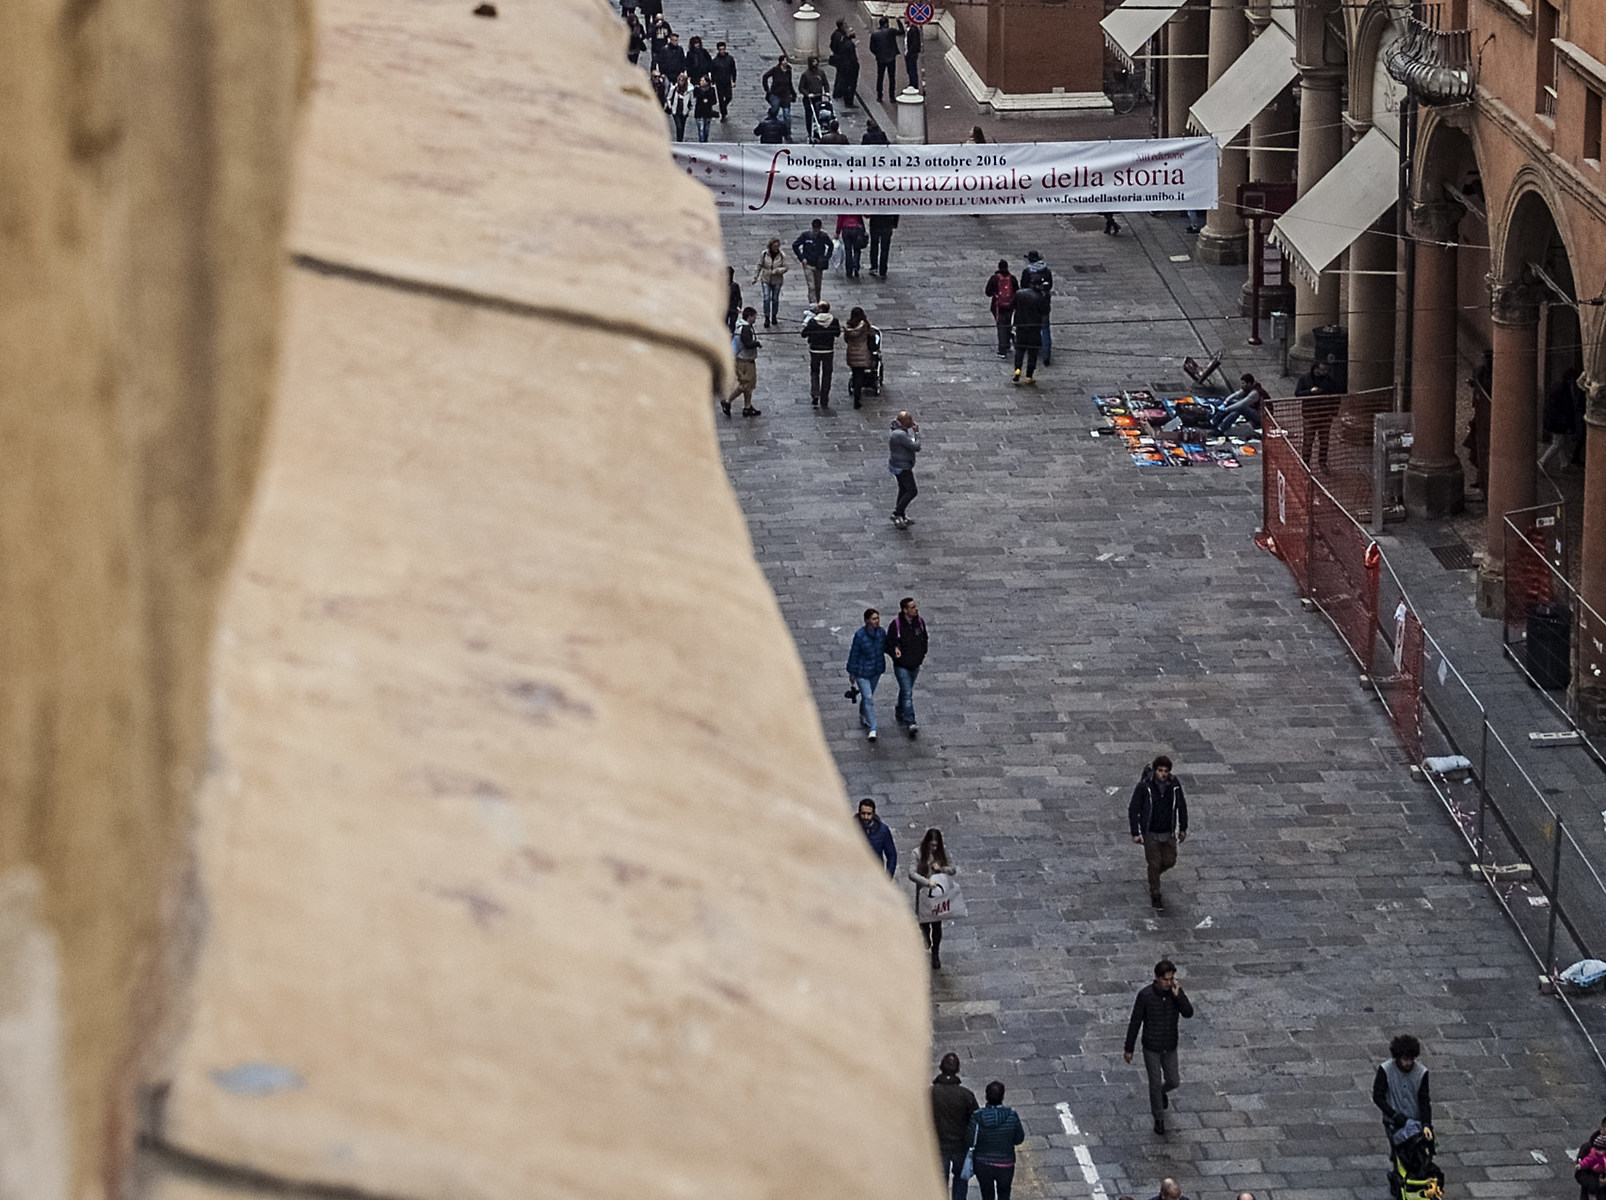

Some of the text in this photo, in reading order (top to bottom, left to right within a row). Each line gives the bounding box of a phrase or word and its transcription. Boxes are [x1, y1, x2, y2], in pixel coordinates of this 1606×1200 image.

[787, 155, 1007, 169] bologna, dal 15 al 23 ottobre 2016
[748, 149, 1185, 211] festa internazionale della storia
[787, 191, 1185, 207] LA STORIA, PATRIMONIO DELL'UMANITÀ www.festadellastoria.unibo.it
